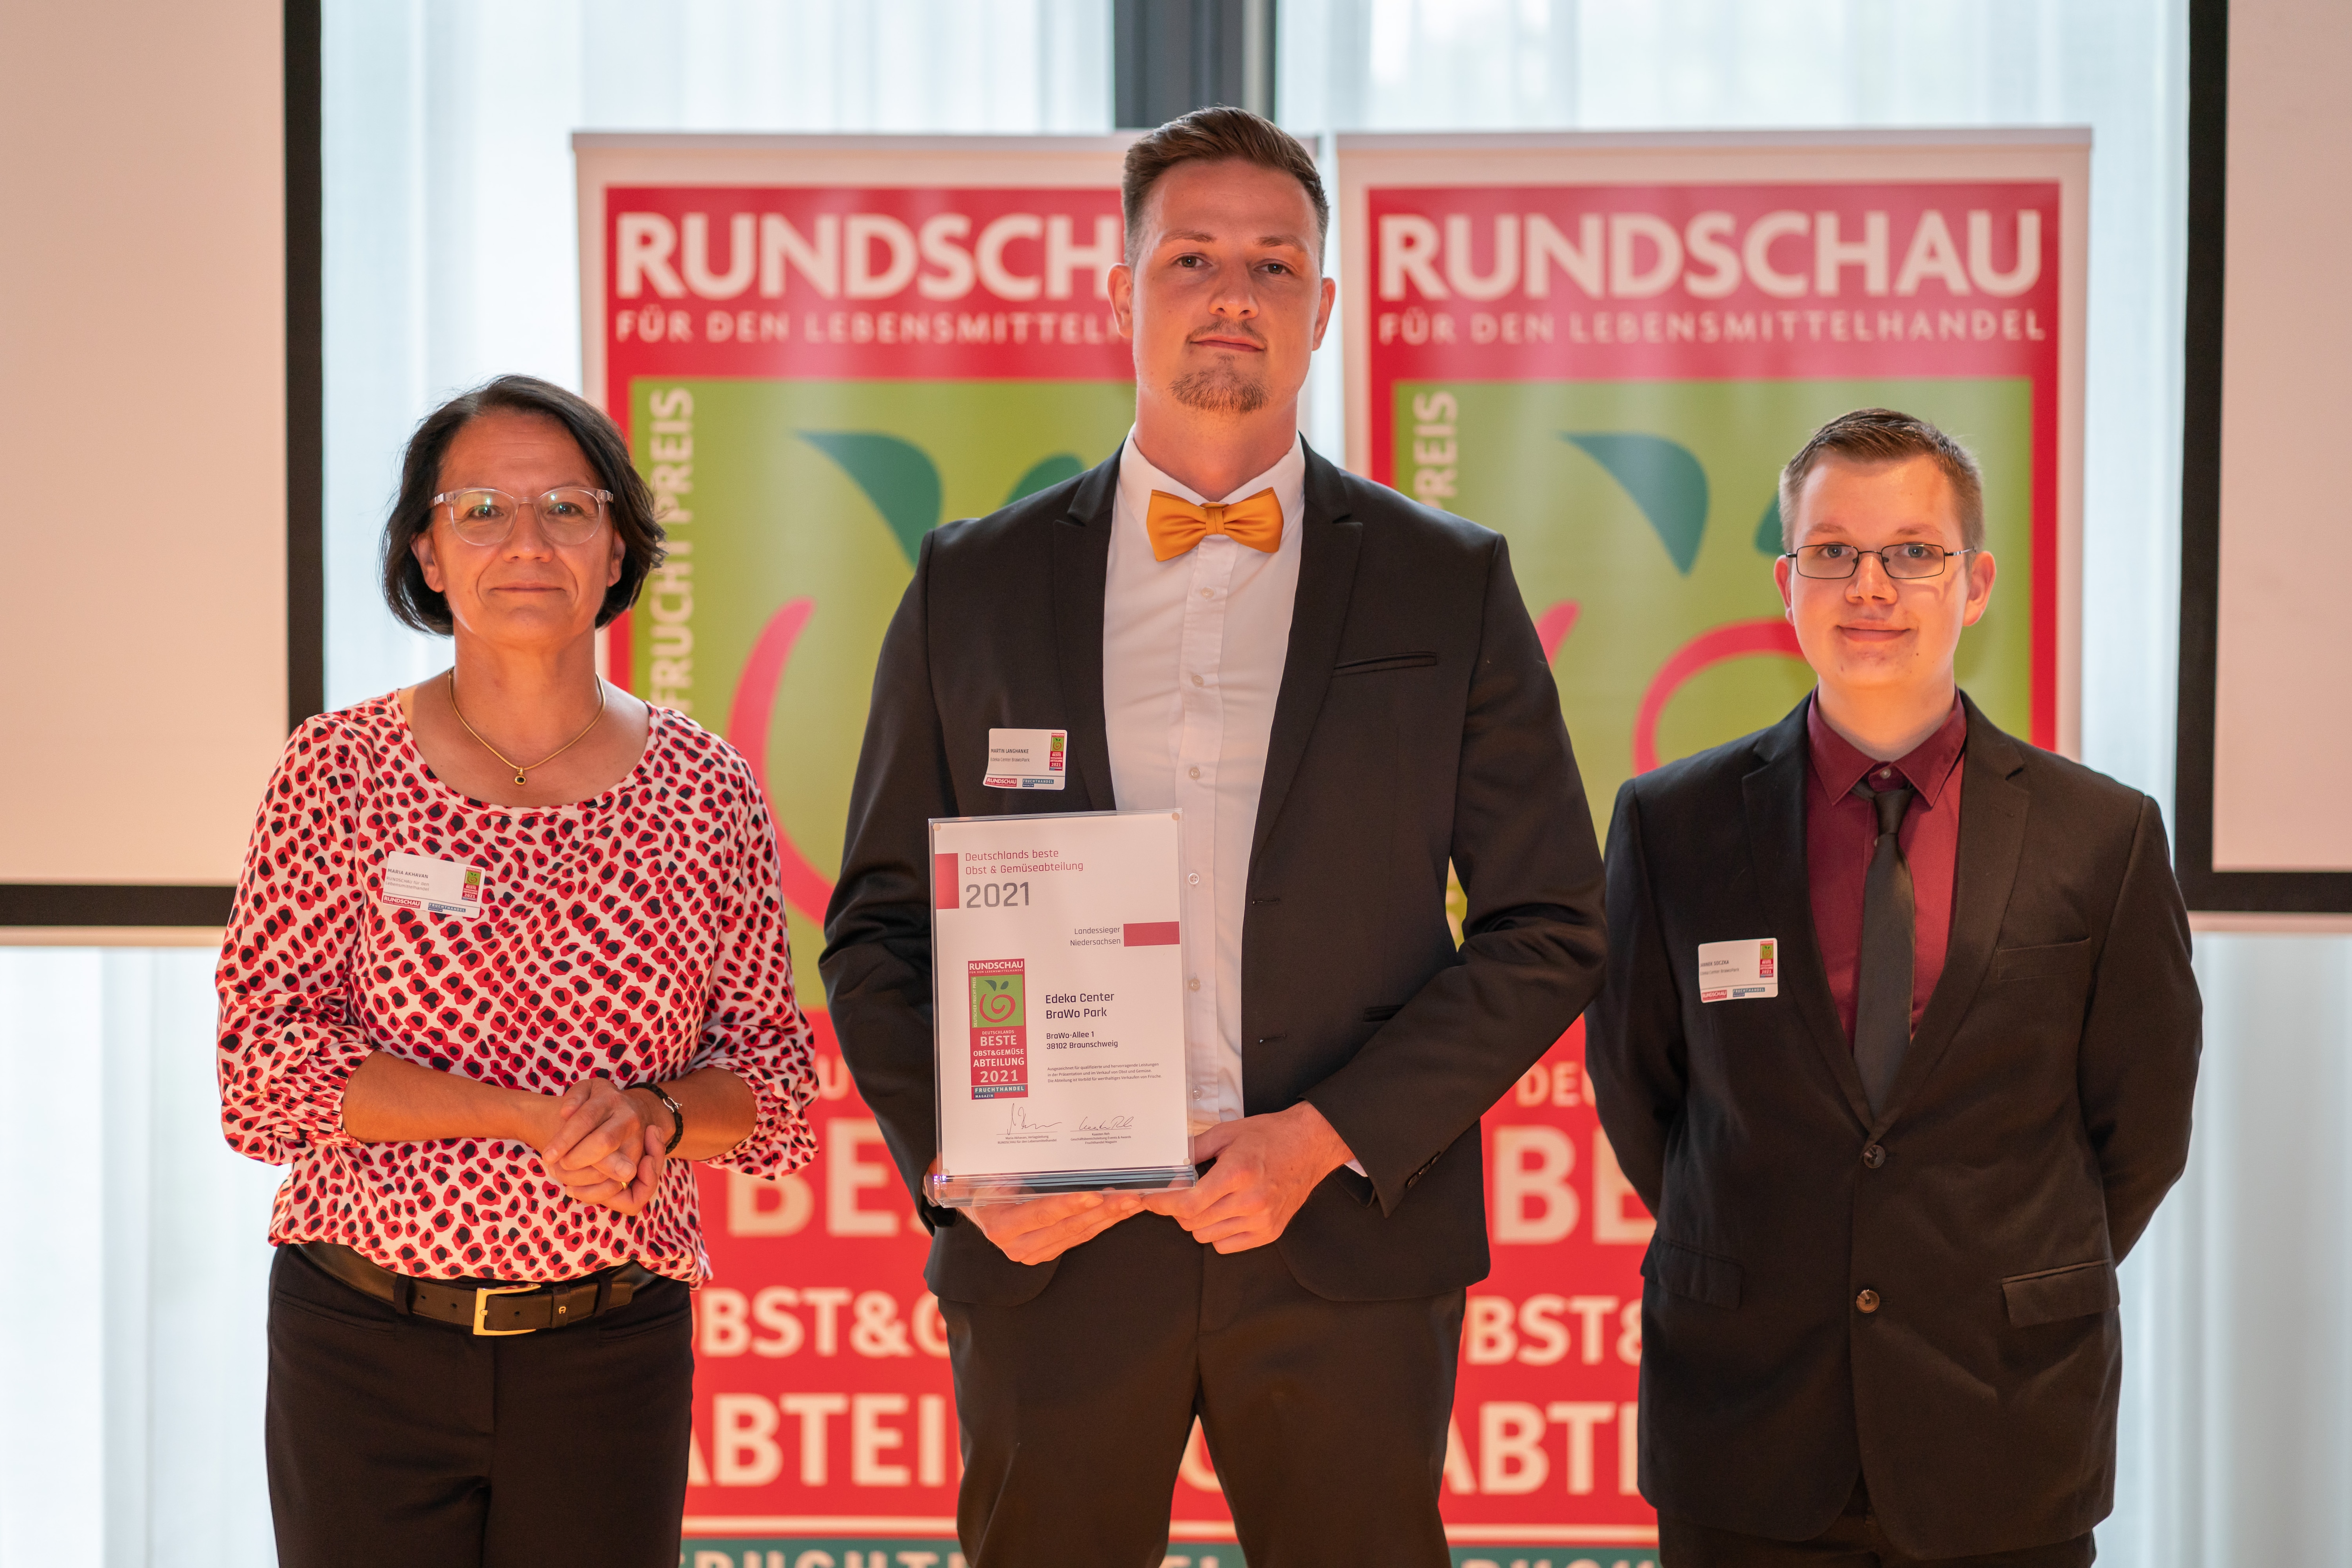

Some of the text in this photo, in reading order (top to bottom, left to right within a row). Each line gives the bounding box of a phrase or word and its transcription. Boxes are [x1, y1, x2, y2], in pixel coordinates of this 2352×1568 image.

[616, 212, 1121, 302] RUNDSCH
[1379, 209, 2042, 301] RUNDSCHAU
[616, 306, 694, 343] FÜR
[706, 310, 789, 342] DEN
[1380, 307, 2045, 345] FÜR DEN LEBENSMITTELHANDEL
[1413, 391, 1457, 509] REIS
[650, 388, 694, 524] PREIS
[965, 849, 1059, 861] Deutschlands beste
[965, 861, 1083, 875] Obst & Gemüseabteilung
[385, 881, 429, 892] Lebensmittelhandel
[966, 882, 1030, 908] 2021
[384, 896, 421, 907] RUNDSCHAU
[429, 903, 466, 913] FRUCHTHANDEL
[1074, 926, 1120, 935] Landessieger
[1070, 937, 1121, 947] Niedersachsen
[969, 961, 1023, 971] RUNDSCHAU
[1046, 993, 1114, 1003] Edeka Center
[1046, 1007, 1107, 1019] BraWo Park
[980, 1035, 1017, 1046] BESTE
[1069, 1040, 1118, 1049] Braunschweig
[973, 1048, 1024, 1057] OBST&GEMÜSE
[973, 1057, 1025, 1067] ABTEILUNG
[980, 1070, 1018, 1083] 2021
